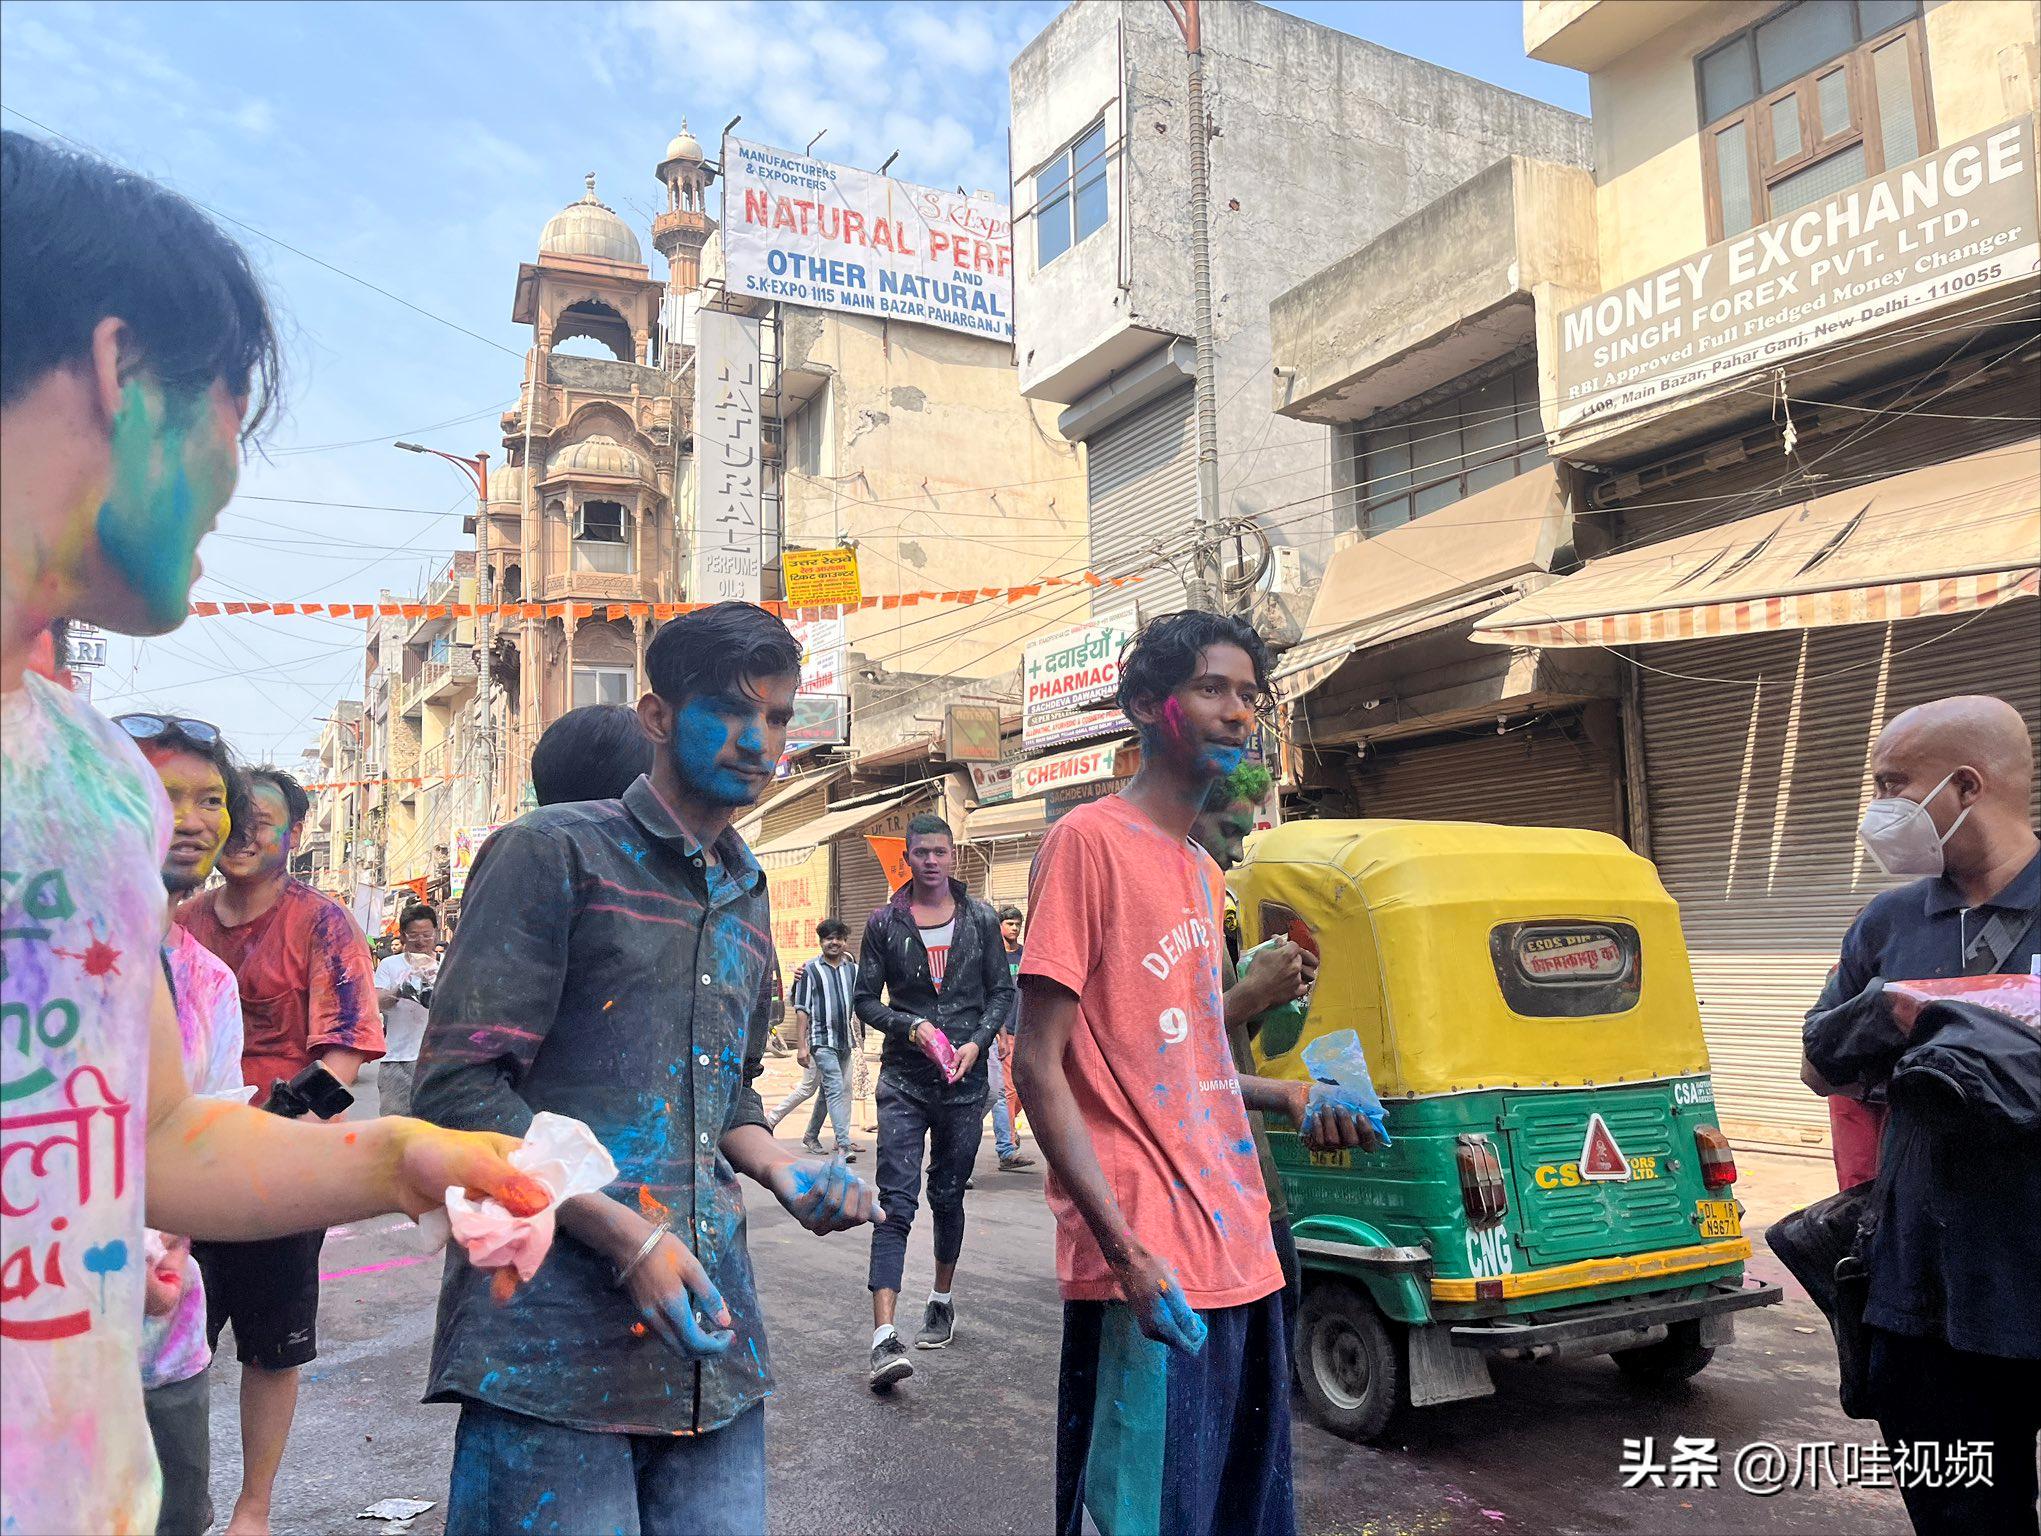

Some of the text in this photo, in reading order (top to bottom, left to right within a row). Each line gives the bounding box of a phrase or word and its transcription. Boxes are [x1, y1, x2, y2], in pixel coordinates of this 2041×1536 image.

[739, 147, 837, 180] MANUFACTURERS
[746, 163, 827, 191] & EXPORTERS
[744, 187, 915, 257] NATURAL
[1563, 125, 2025, 353] MONEY EXCHANGE
[767, 249, 1006, 318] OTHER NATURAL
[953, 270, 983, 287] AND
[1593, 208, 1980, 369] SINGH FOREX PVT. LTD.
[840, 291, 875, 310] MAIN
[880, 297, 925, 317] BAZAR
[928, 305, 1001, 336] PAHARGANJ
[1568, 226, 2022, 401] RBI Approved Full Fledged Money Changer
[1622, 386, 1656, 405] Main
[1660, 369, 1707, 392] Bazar,
[1712, 349, 1761, 374] Pahar
[1764, 331, 1809, 355] Ganj,
[1814, 317, 1856, 339] New
[1861, 295, 1909, 322] Delhi
[1927, 263, 2002, 300] 110055
[705, 555, 758, 577] PERFUME
[719, 579, 745, 598] OILS
[1045, 627, 1113, 673] दवाईयाँ
[1031, 695, 1071, 713] SACHDEVA
[1027, 753, 1102, 786] CHEMIST
[1049, 784, 1093, 803] SACHDEVA
[1159, 1007, 1188, 1044] 9
[1674, 1082, 1699, 1105] CSA
[1633, 1168, 1658, 1180] LTD.
[1704, 1203, 1717, 1218] DL
[1706, 1219, 1736, 1235] N9671
[1465, 1225, 1513, 1277] CNG
